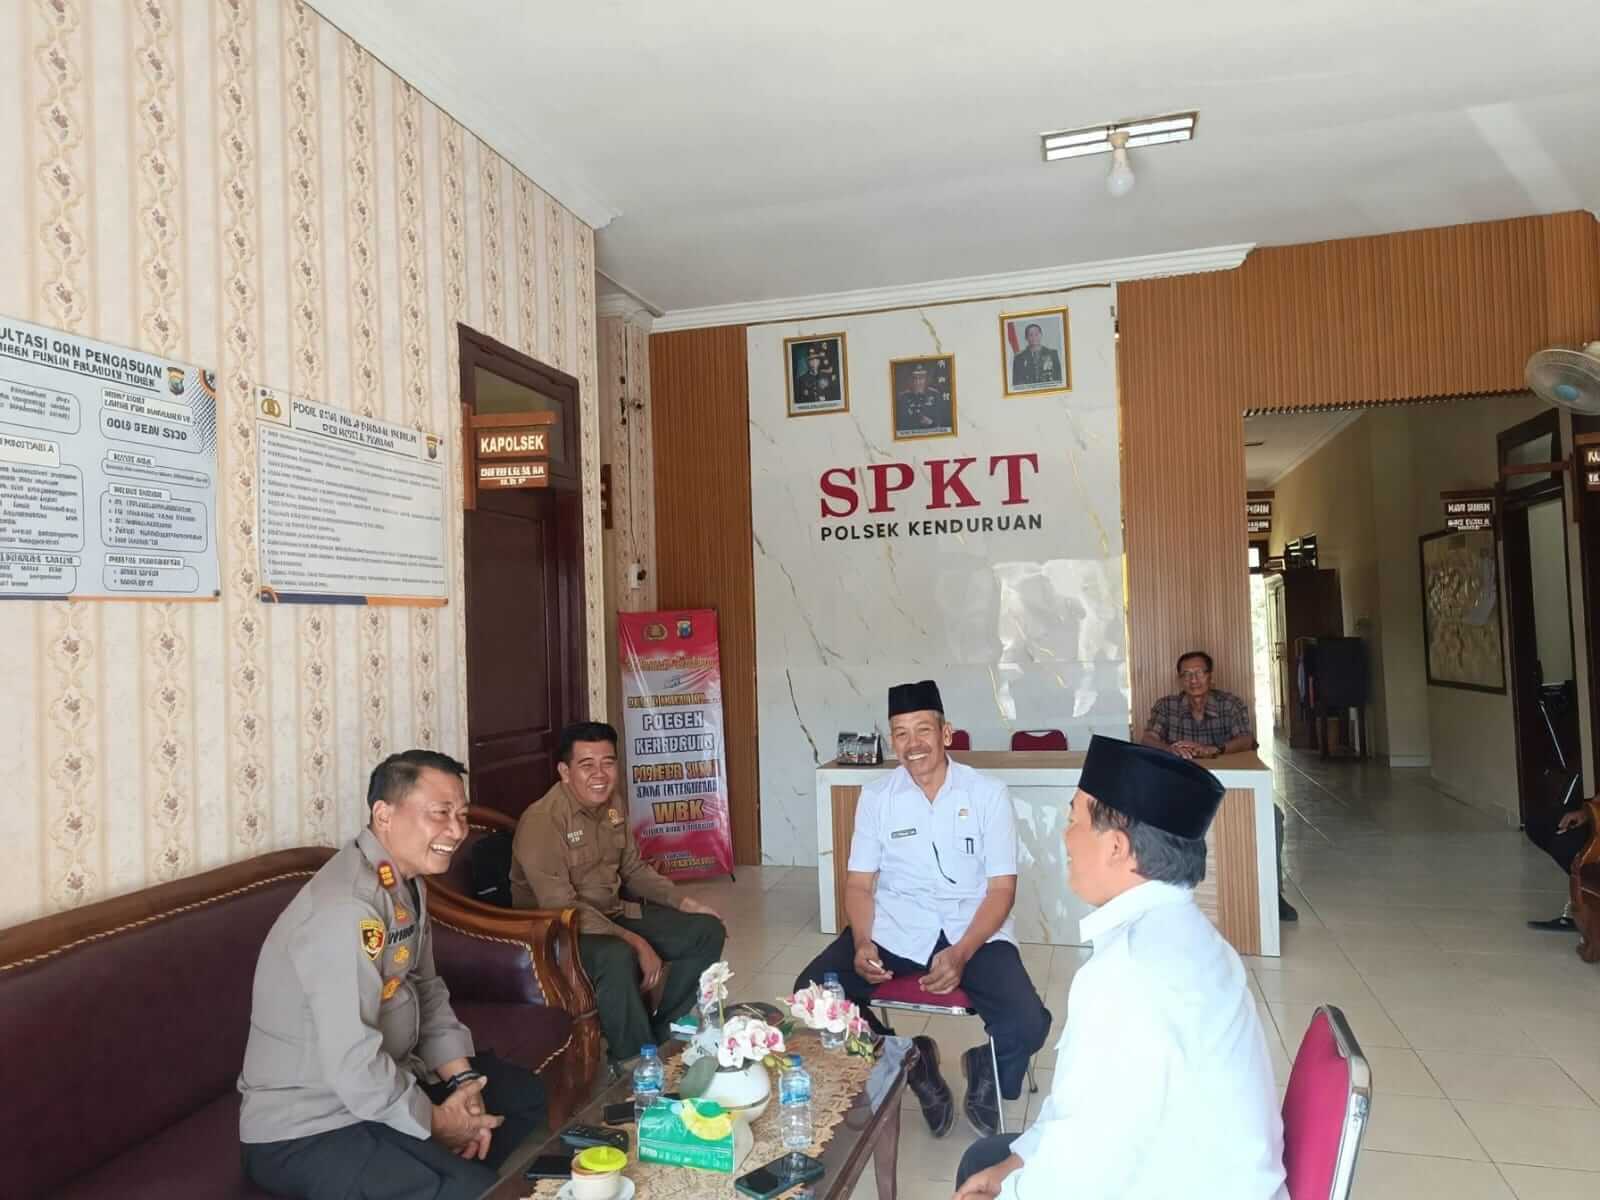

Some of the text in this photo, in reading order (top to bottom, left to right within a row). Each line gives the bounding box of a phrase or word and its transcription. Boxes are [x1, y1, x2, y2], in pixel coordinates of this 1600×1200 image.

[481, 434, 544, 453] KAPOLSEK
[819, 453, 1039, 518] SPKT
[821, 514, 1042, 541] POLSEK KENDURUAN
[653, 799, 704, 824] WBK
